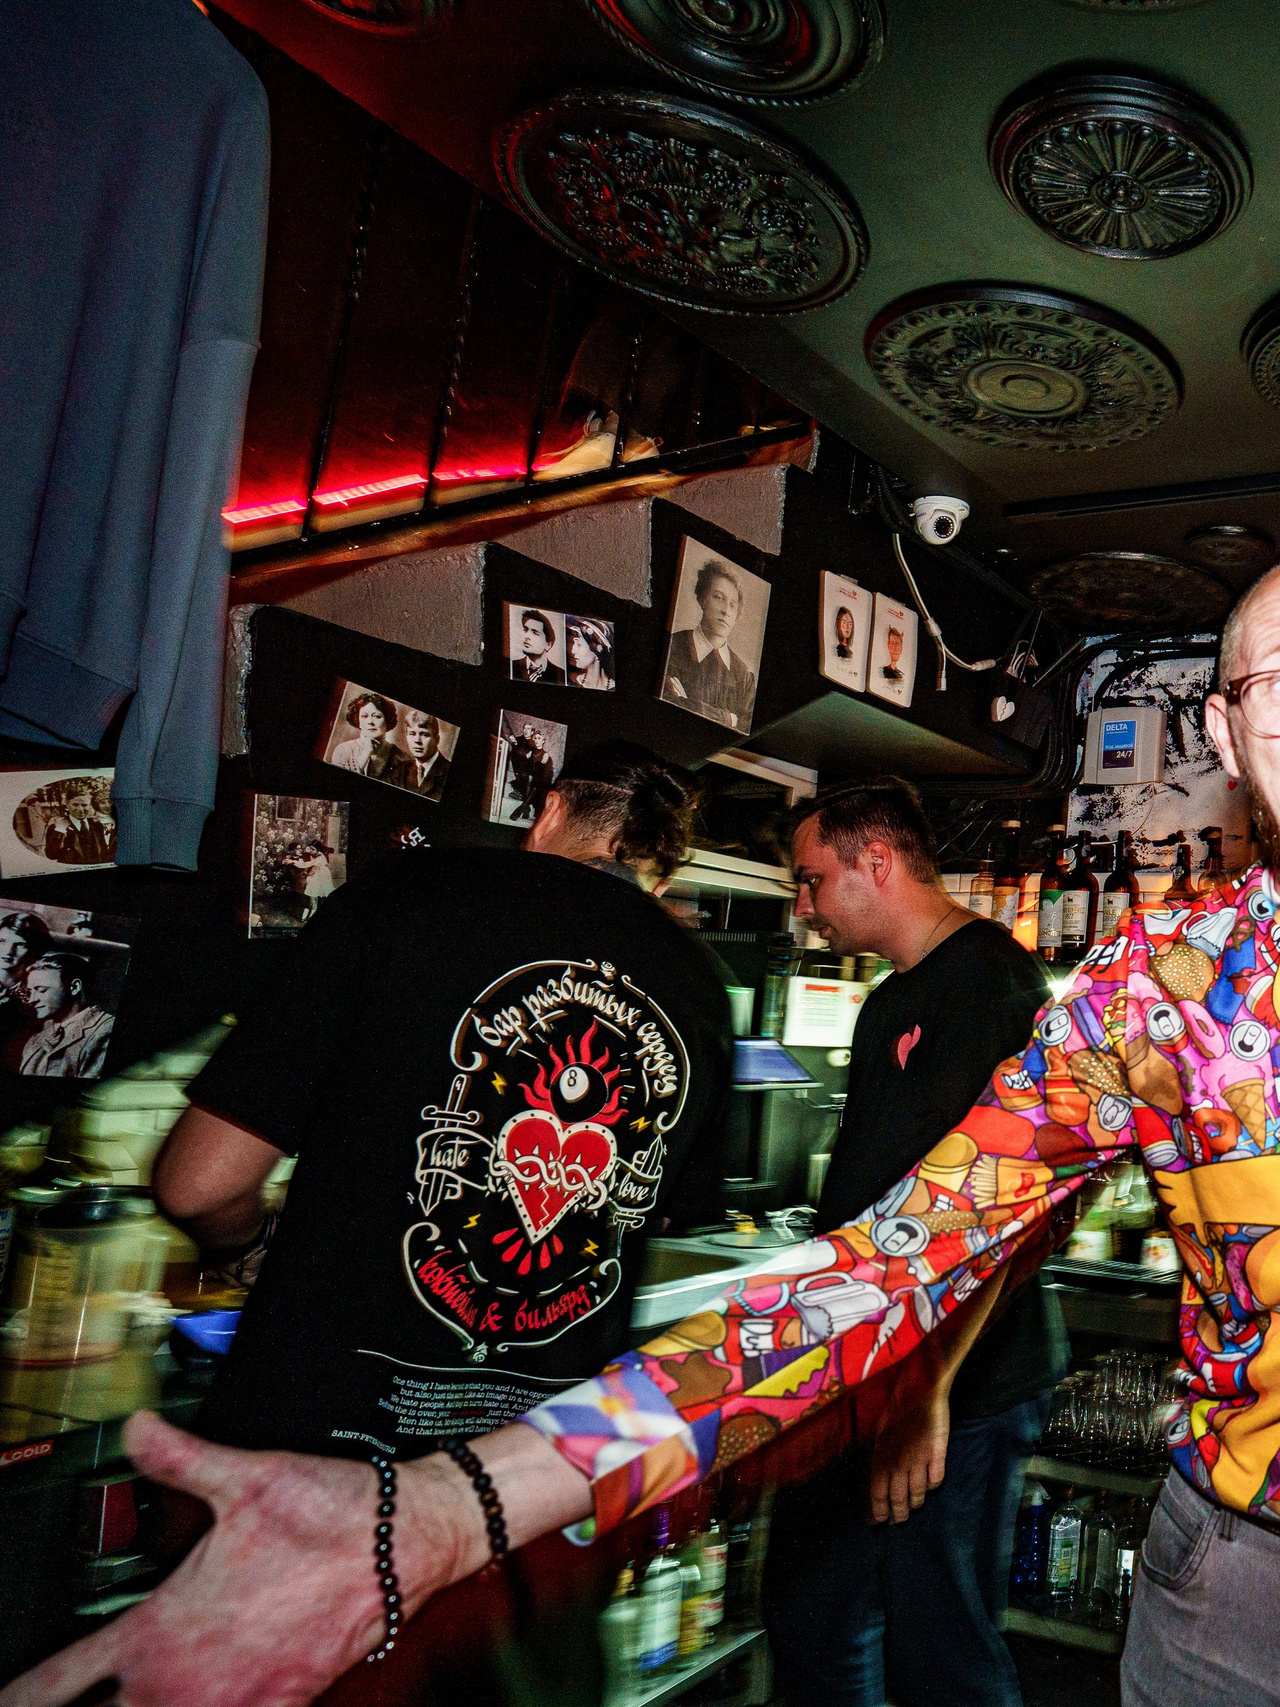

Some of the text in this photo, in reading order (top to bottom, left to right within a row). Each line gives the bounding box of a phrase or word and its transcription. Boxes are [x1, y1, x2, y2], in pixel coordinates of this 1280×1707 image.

[1106, 723, 1128, 731] DELTA
[471, 1006, 532, 1055] бар
[522, 964, 642, 1032] разбитых
[567, 1069, 578, 1087] 8
[430, 1134, 480, 1170] hate
[615, 1172, 650, 1202] love
[479, 1302, 503, 1332] &
[406, 1380, 429, 1390] thing
[400, 1388, 413, 1396] but
[414, 1391, 432, 1399] also
[431, 1392, 446, 1400] just
[485, 1392, 508, 1400] image
[394, 1406, 408, 1414] the
[400, 1397, 419, 1407] hate
[511, 1403, 528, 1411] And
[398, 1416, 417, 1425] Men
[419, 1418, 434, 1426] like
[396, 1426, 415, 1434] And
[416, 1428, 433, 1436] that
